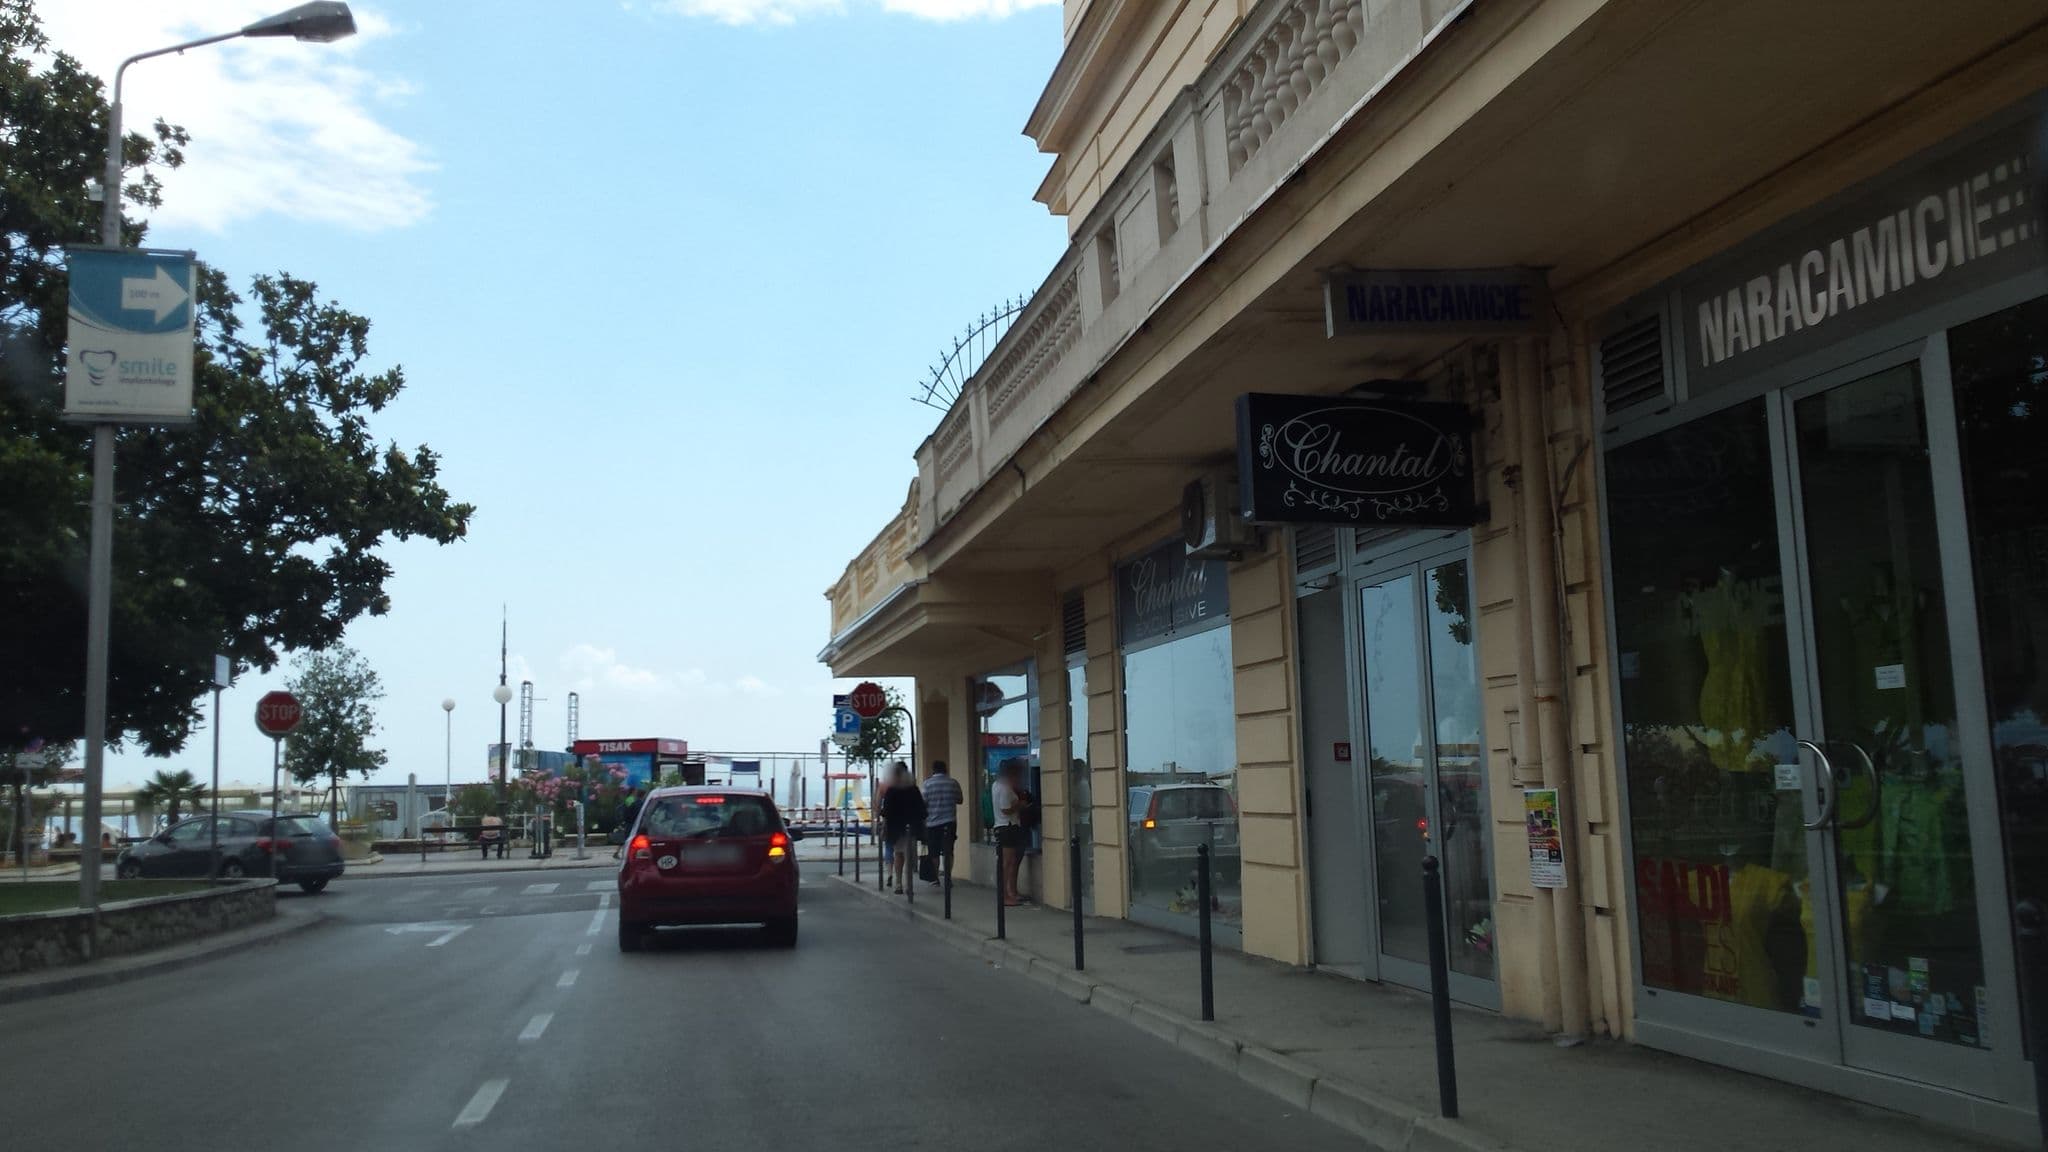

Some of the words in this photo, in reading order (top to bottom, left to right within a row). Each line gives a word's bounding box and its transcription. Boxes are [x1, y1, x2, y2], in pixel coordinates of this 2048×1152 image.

[1346, 283, 1532, 322] NARACAMICIE
[119, 357, 177, 376] smile
[1284, 420, 1445, 479] Chantal
[1130, 557, 1208, 617] Chantal
[853, 693, 884, 708] STOP
[260, 703, 298, 721] STOP
[842, 713, 854, 729] P
[598, 742, 632, 752] TISAK
[661, 857, 674, 868] HR
